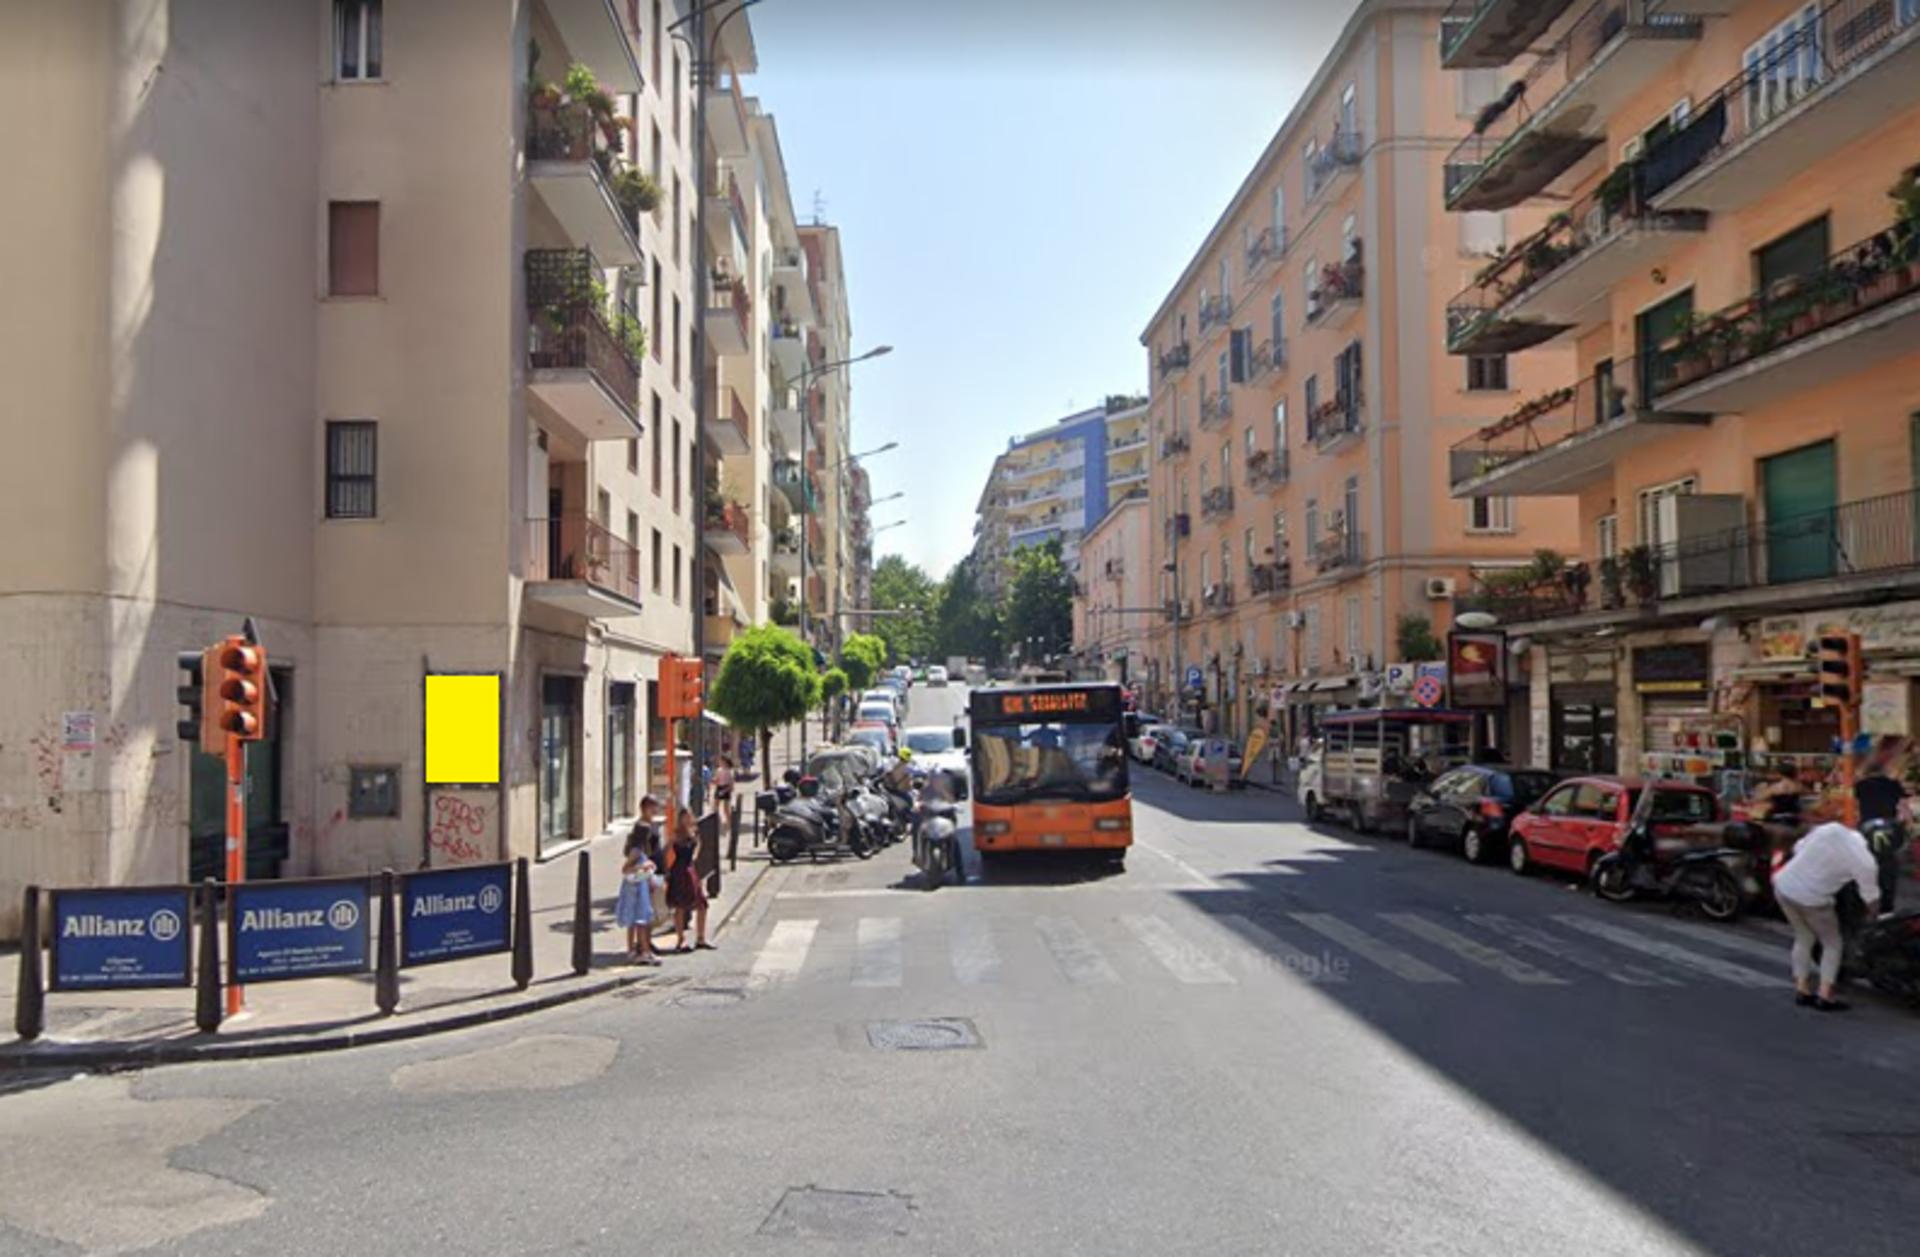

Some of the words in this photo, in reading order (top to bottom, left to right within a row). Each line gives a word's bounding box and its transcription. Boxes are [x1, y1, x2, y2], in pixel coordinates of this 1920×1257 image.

[1188, 669, 1200, 686] P
[1389, 667, 1403, 684] P
[411, 893, 476, 917] Allianz
[62, 914, 145, 938] Allianz
[240, 908, 325, 932] Allianz
